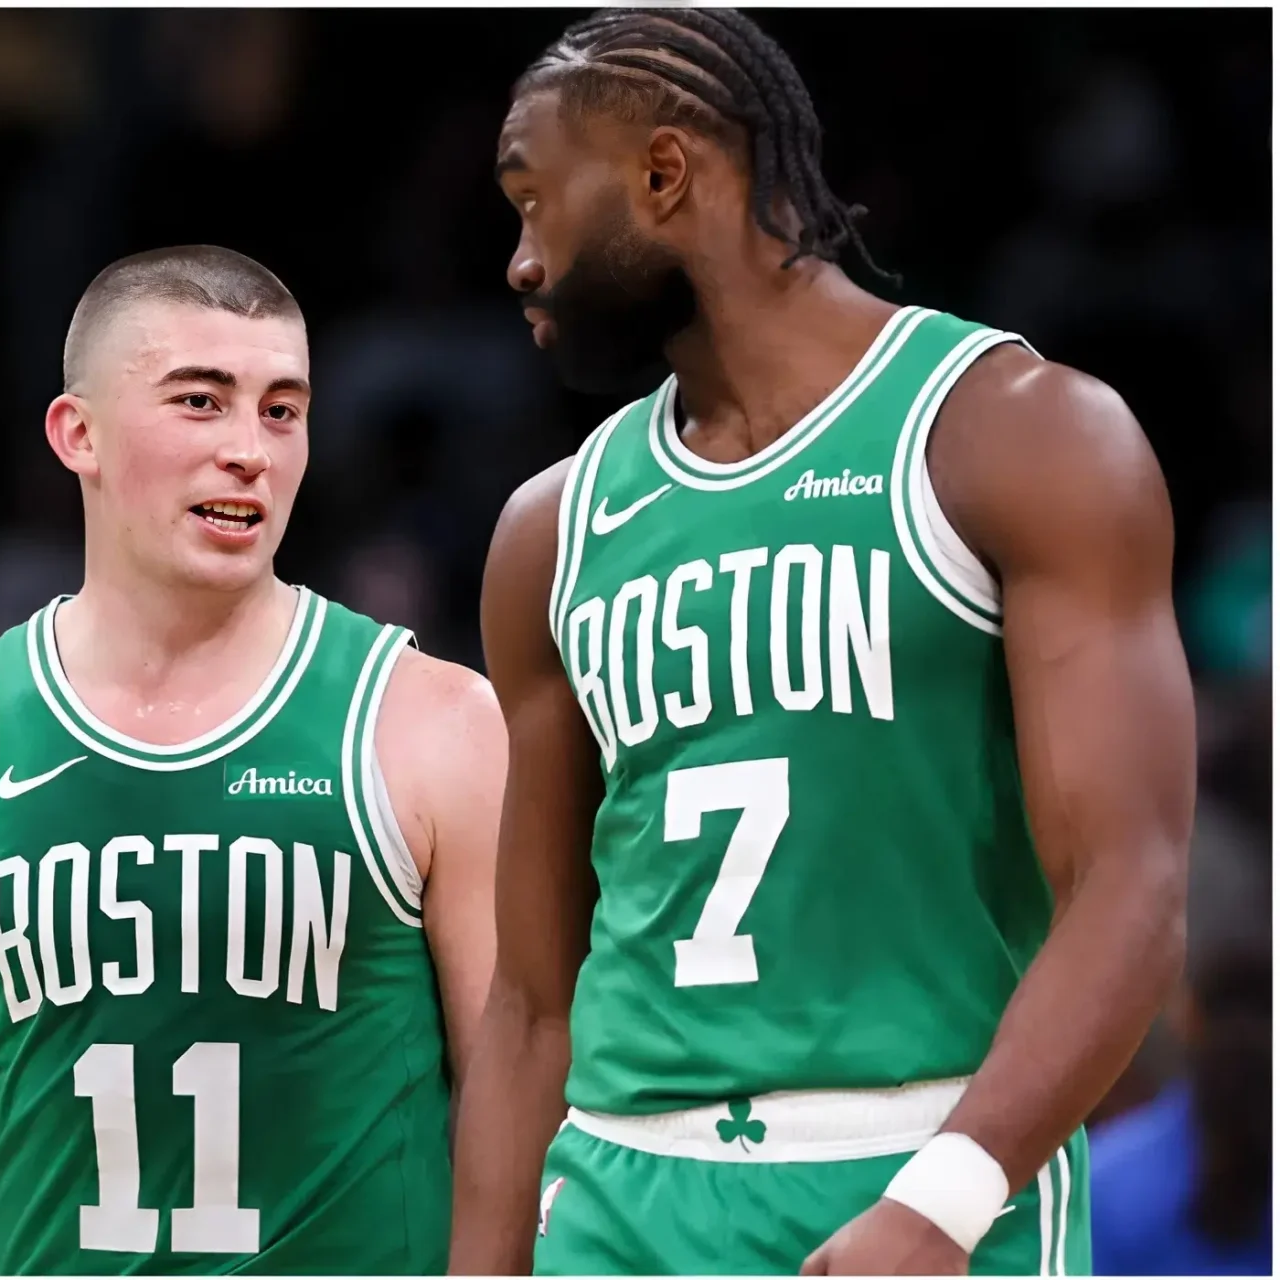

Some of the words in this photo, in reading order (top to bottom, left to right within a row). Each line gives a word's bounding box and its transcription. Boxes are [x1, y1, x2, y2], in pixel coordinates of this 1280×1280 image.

[783, 469, 883, 501] Amica
[567, 543, 894, 773] BOSTON
[228, 767, 333, 797] Amica
[664, 757, 790, 987] 7
[74, 1042, 260, 1253] 11
